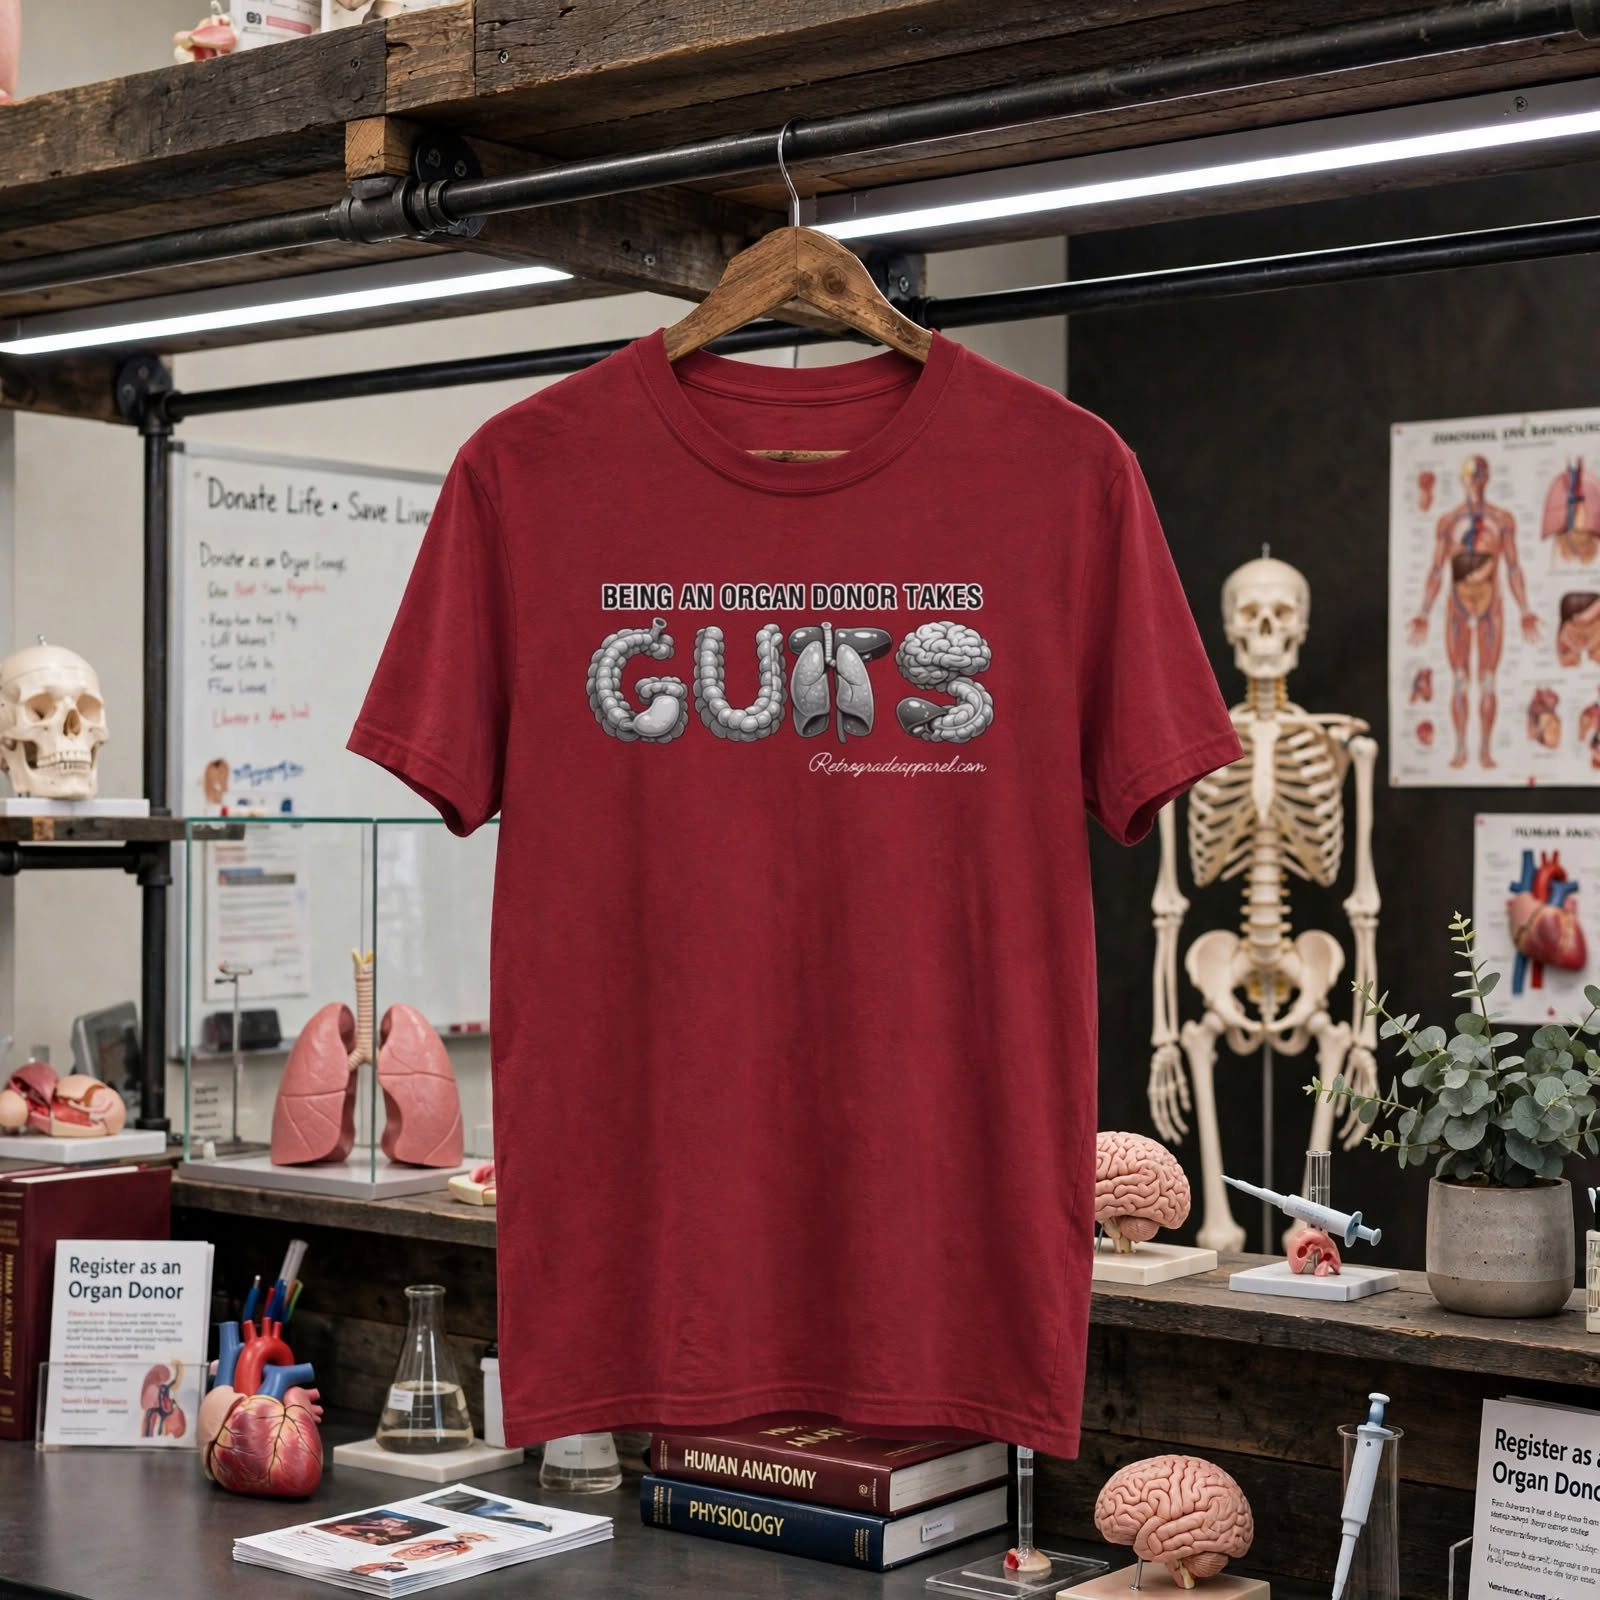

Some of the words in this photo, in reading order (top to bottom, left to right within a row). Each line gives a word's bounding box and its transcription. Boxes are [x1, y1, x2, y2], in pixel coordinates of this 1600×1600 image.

[208, 476, 277, 512] Donate
[286, 485, 324, 517] Life
[396, 495, 431, 526] Live
[602, 583, 673, 611] BEING
[679, 583, 714, 611] AN
[720, 583, 804, 611] ORGAN
[810, 583, 897, 611] DONOR
[904, 583, 983, 610] TAKES
[586, 617, 994, 744] GUTS
[809, 752, 988, 777] Retrogradeapparel.com
[70, 1256, 136, 1279] Register
[140, 1262, 157, 1275] as
[162, 1262, 181, 1275] an
[68, 1281, 122, 1303] Organ
[128, 1281, 184, 1300] Donor
[1495, 1428, 1568, 1461] Register
[1572, 1447, 1592, 1466] as
[684, 1449, 738, 1476] HUMAN
[741, 1459, 817, 1490] ANATOMY
[1492, 1461, 1549, 1494] Organ
[1554, 1471, 1600, 1502] Dono
[689, 1500, 785, 1537] PHYSIOLOGY
